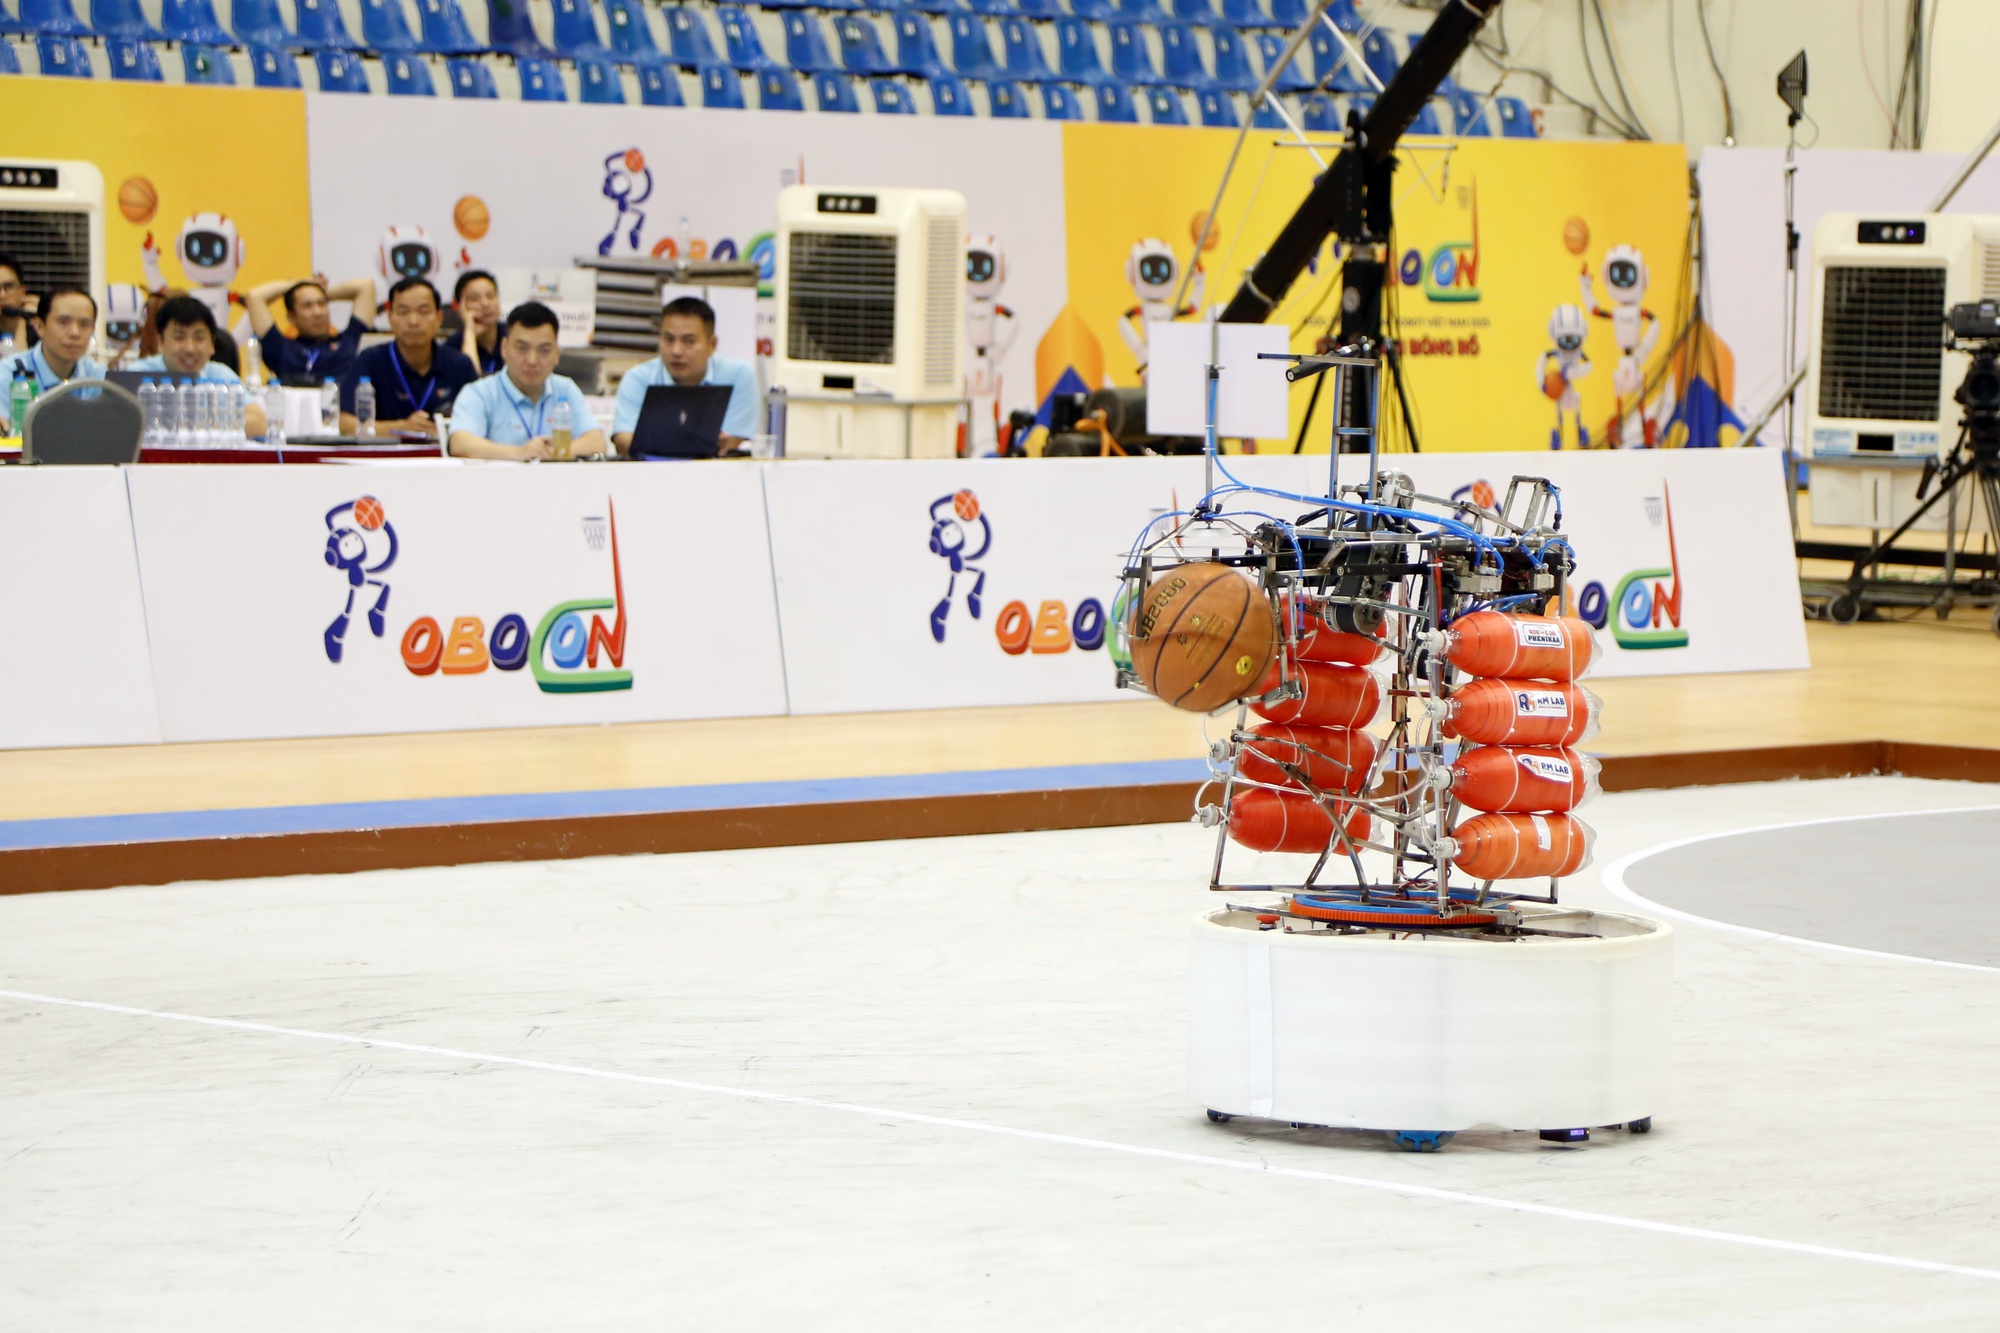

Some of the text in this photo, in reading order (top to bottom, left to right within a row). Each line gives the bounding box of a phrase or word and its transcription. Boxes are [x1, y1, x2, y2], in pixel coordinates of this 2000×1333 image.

[1550, 697, 1565, 706] LAB
[1541, 762, 1554, 771] RM
[1555, 765, 1570, 775] LAB
